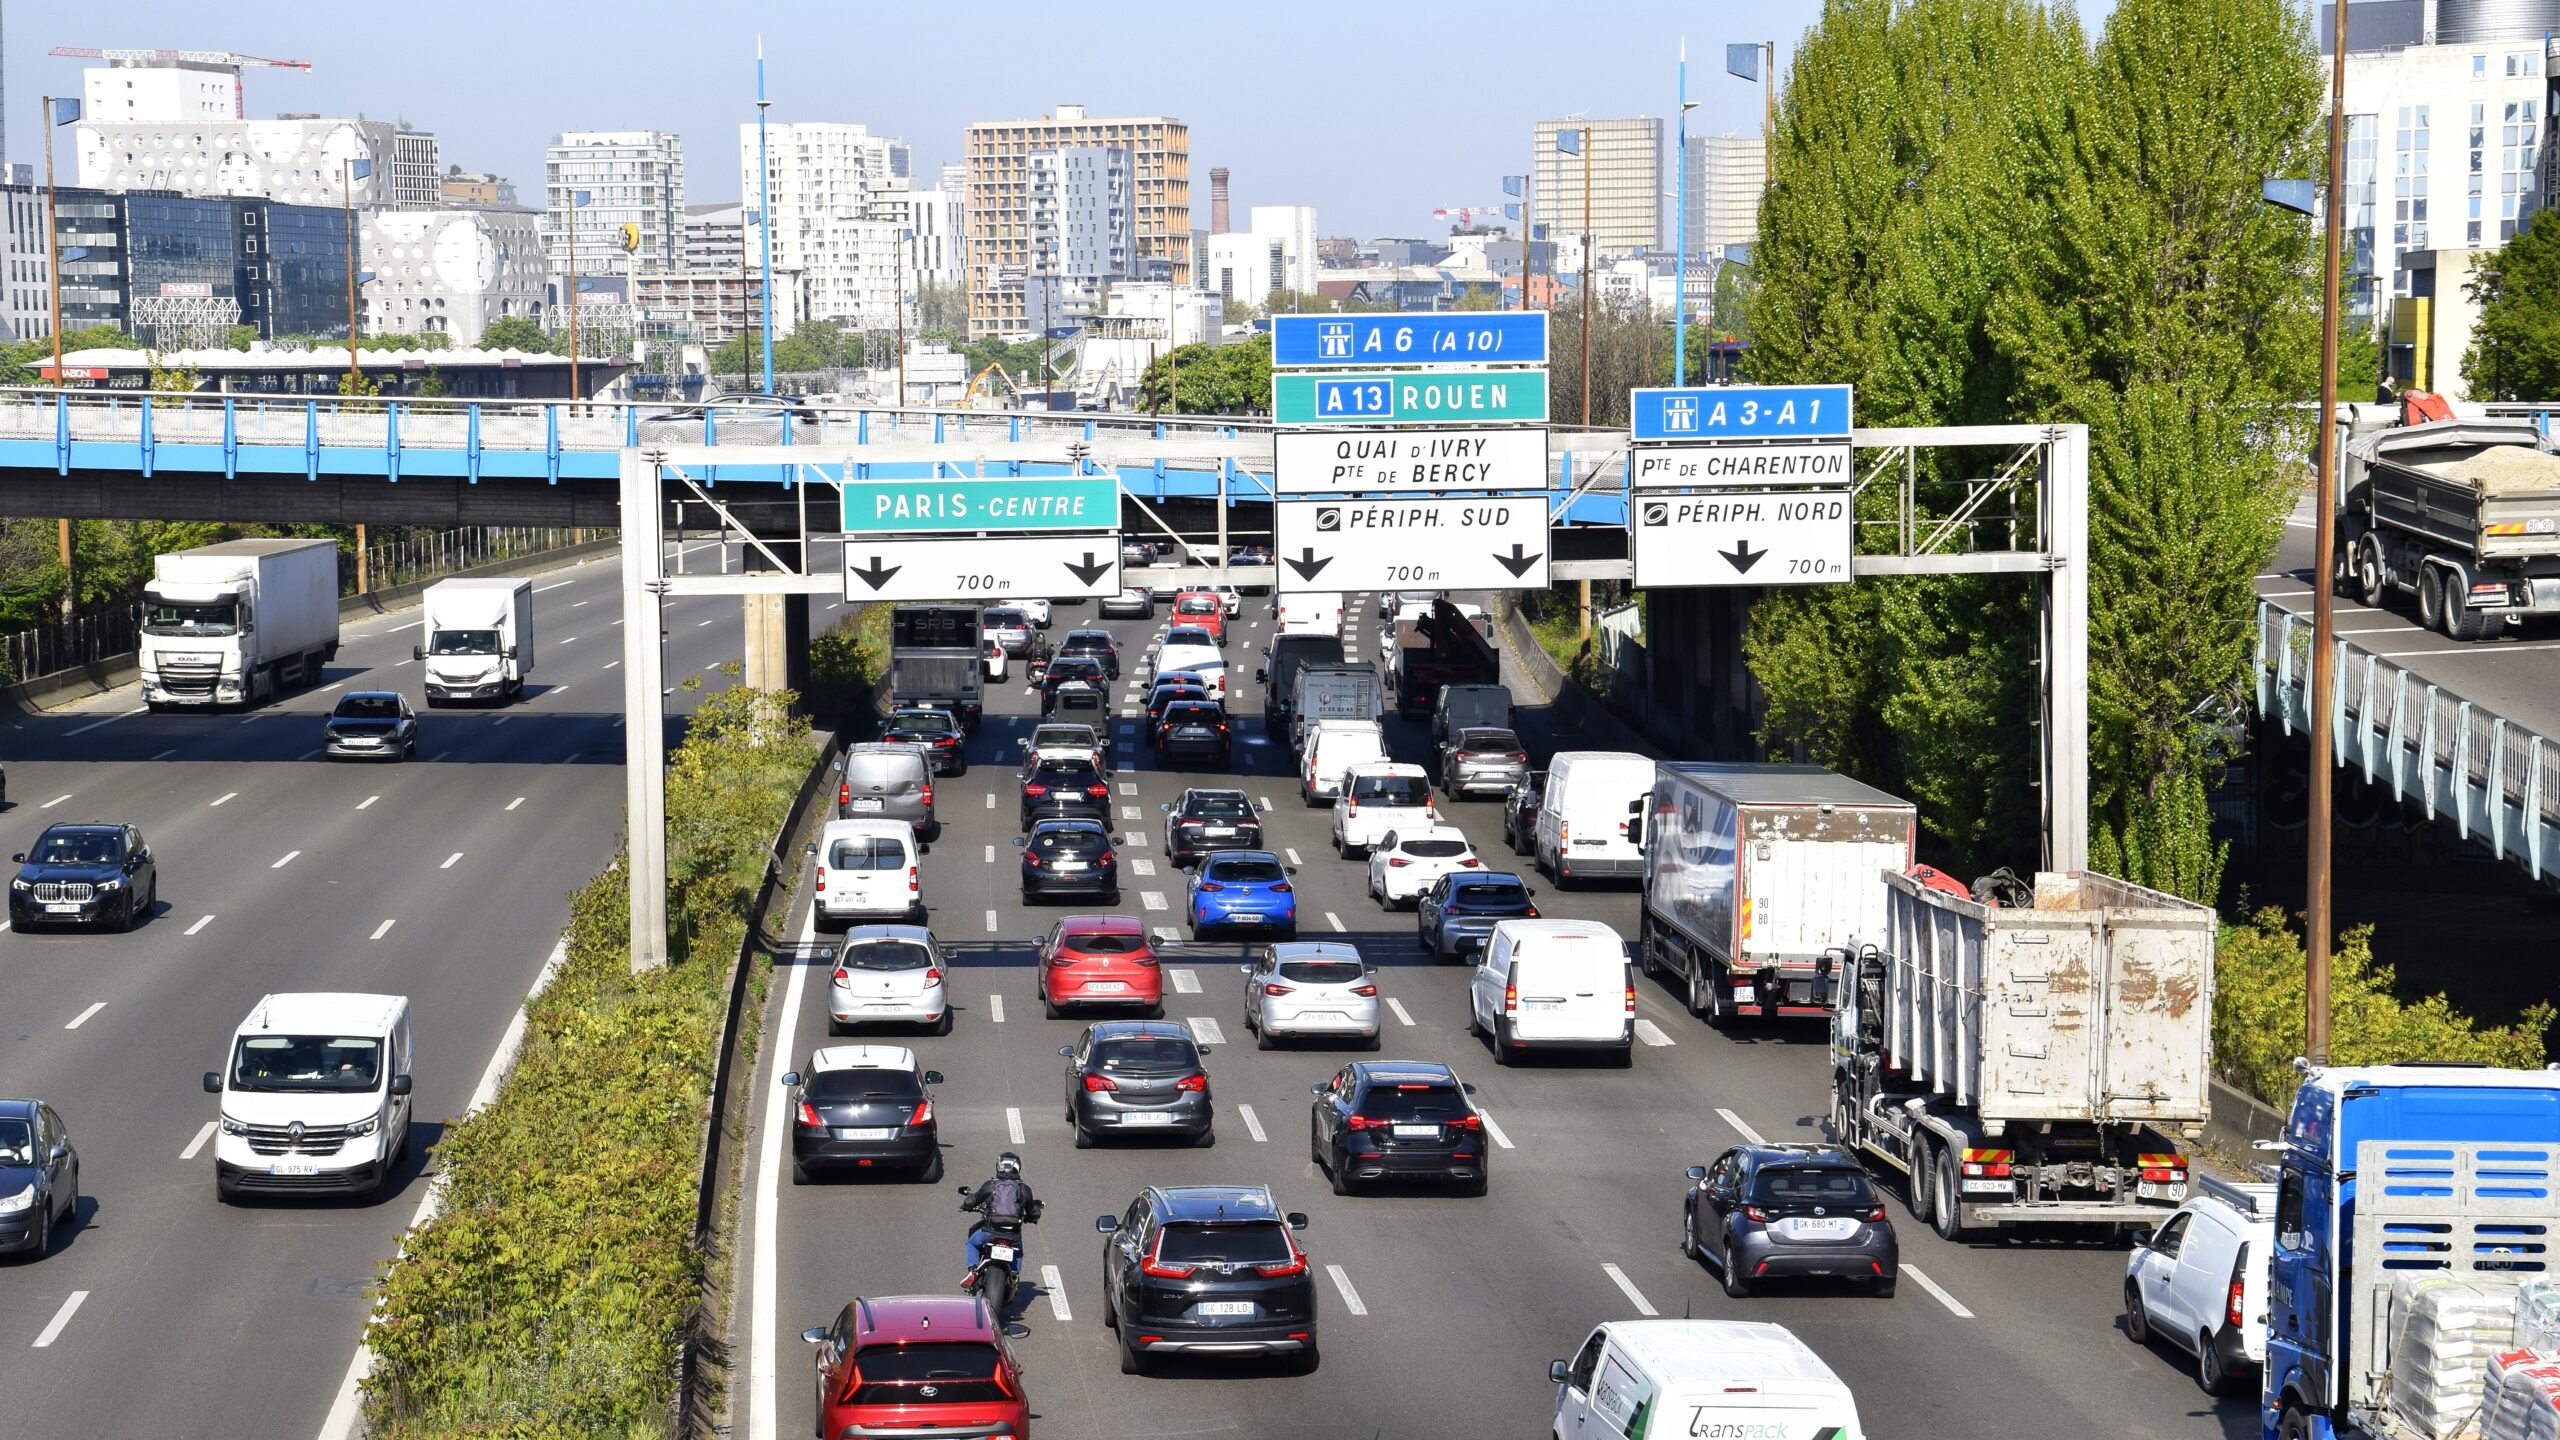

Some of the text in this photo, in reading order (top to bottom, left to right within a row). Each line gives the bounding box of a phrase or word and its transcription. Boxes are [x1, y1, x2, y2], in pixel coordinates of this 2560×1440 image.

[1363, 327, 1382, 353] A
[1395, 326, 1413, 352] 6
[1467, 329, 1503, 353] 10)
[61, 369, 90, 378] ABONI
[1326, 385, 1383, 412] A 13
[1403, 384, 1507, 410] ROUEN
[1707, 401, 1727, 426] A
[1336, 440, 1397, 460] QUAI
[1412, 463, 1491, 483] BERCY
[1707, 455, 1843, 476] CHARENTON
[1350, 505, 1510, 529] PÉRIPH. SUD
[1677, 500, 1843, 523] PÉRIPH. NORD
[1387, 565, 1440, 581] 700 m
[1788, 558, 1842, 575] 700 m
[956, 574, 1010, 590] 700 m
[1758, 897, 1769, 909] 90
[1758, 913, 1768, 925] 80
[2140, 1182, 2185, 1198] 80 90
